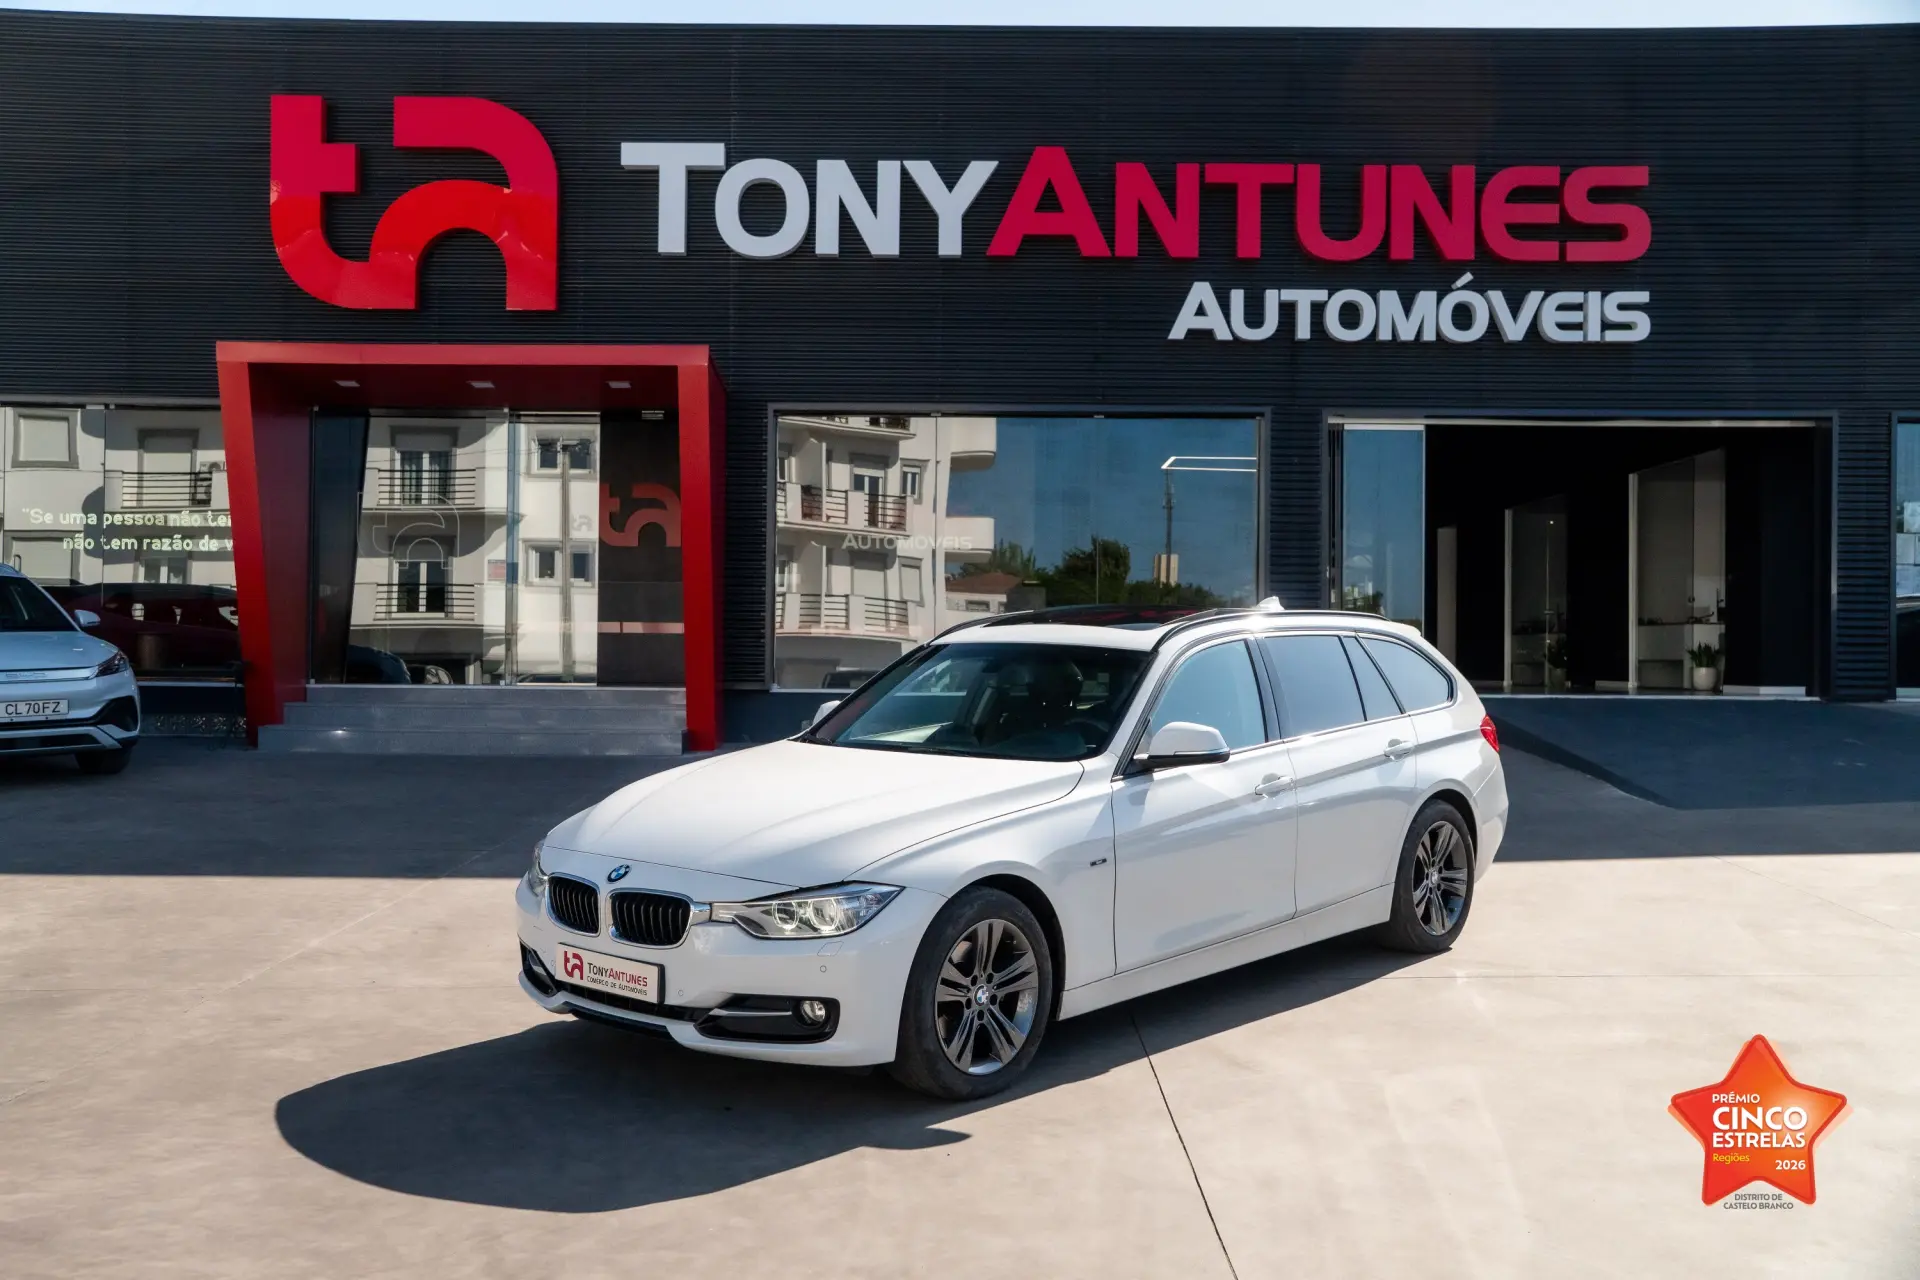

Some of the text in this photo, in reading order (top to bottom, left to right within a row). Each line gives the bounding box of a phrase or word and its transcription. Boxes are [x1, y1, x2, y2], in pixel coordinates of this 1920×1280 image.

[1167, 272, 1652, 342] AUTOMÓVEIS
[59, 513, 97, 525] uma
[103, 513, 165, 528] pessoa
[169, 510, 200, 526] não
[63, 533, 94, 550] não
[100, 535, 138, 550] tem
[143, 534, 193, 550] razão
[199, 534, 218, 551] de
[5, 701, 60, 716] CL 70 FZ
